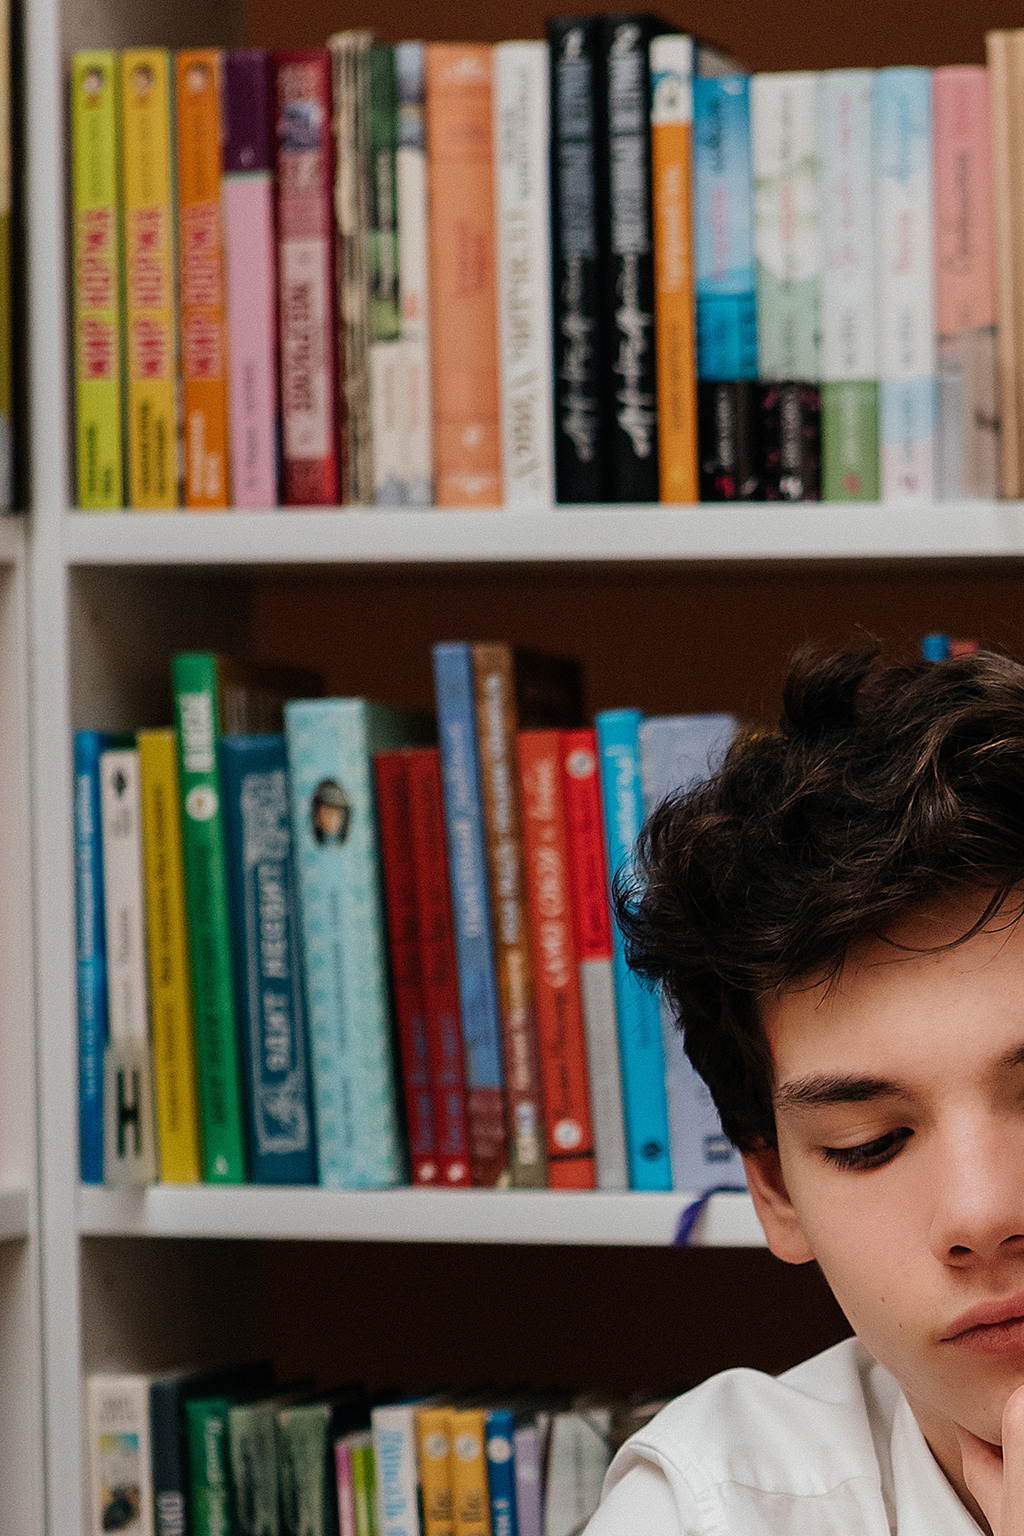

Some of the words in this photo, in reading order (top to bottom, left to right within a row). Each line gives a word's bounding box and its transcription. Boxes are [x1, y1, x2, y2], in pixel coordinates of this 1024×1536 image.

[80, 314, 116, 381] МИР
[131, 314, 168, 380] МИР
[260, 863, 288, 978] НЕСБИТ
[262, 991, 289, 1072] ЭДИТ
